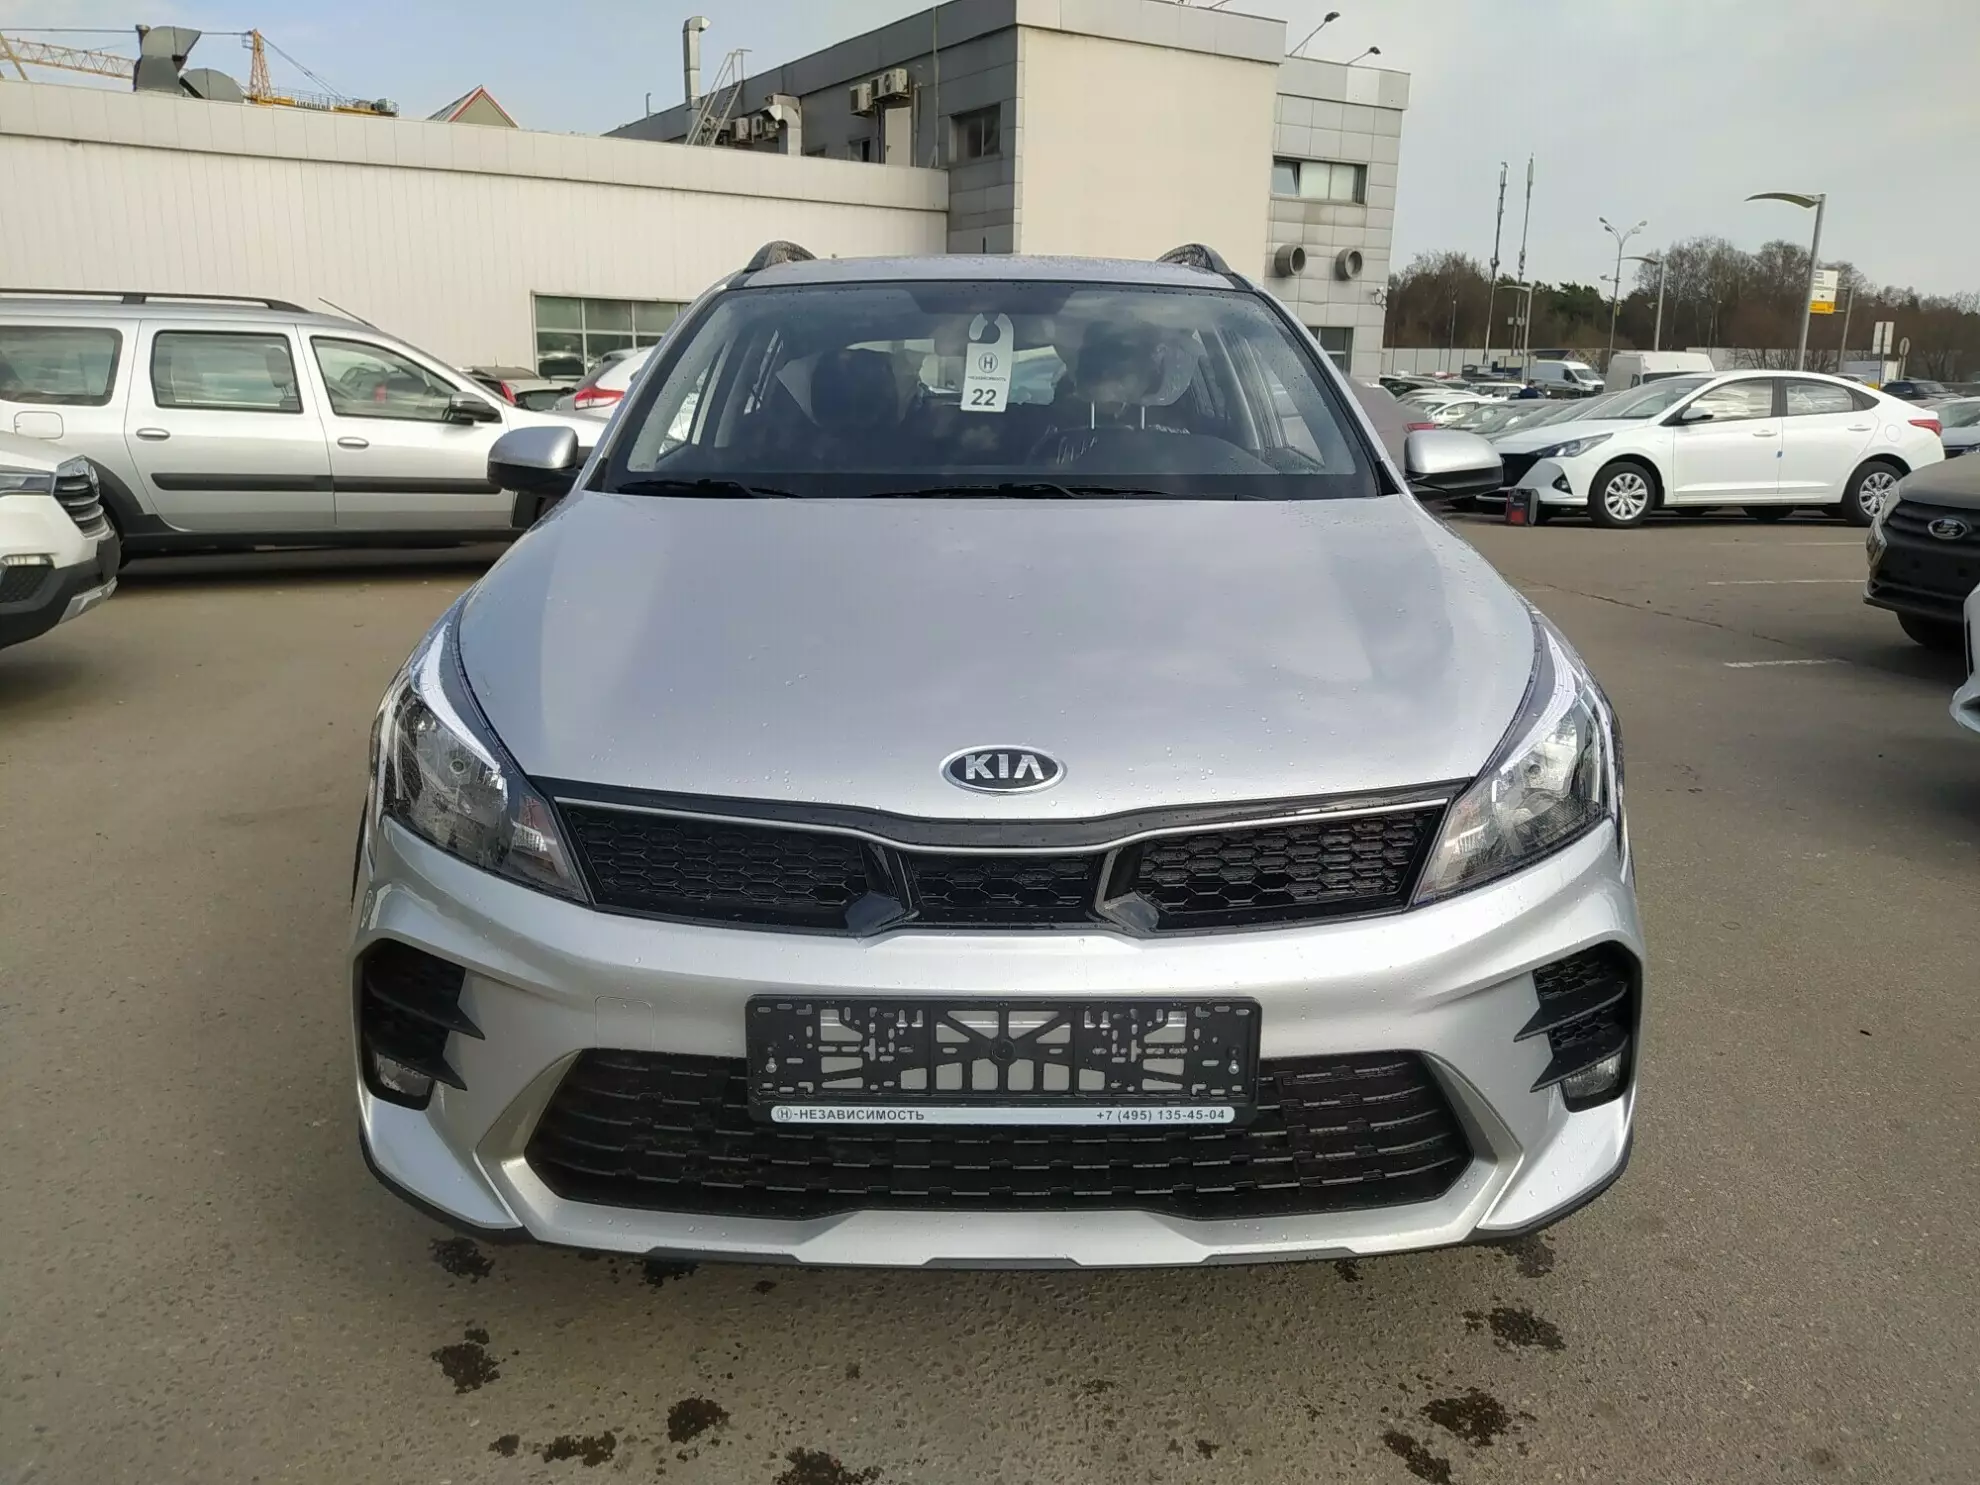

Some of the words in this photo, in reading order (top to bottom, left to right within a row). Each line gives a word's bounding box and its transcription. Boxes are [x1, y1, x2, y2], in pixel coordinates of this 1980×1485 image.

[970, 388, 997, 406] 22
[964, 753, 1045, 780] KIA
[1096, 1109, 1113, 1121] +7
[1117, 1109, 1153, 1123] (495)
[1157, 1109, 1225, 1120] 135-45-04
